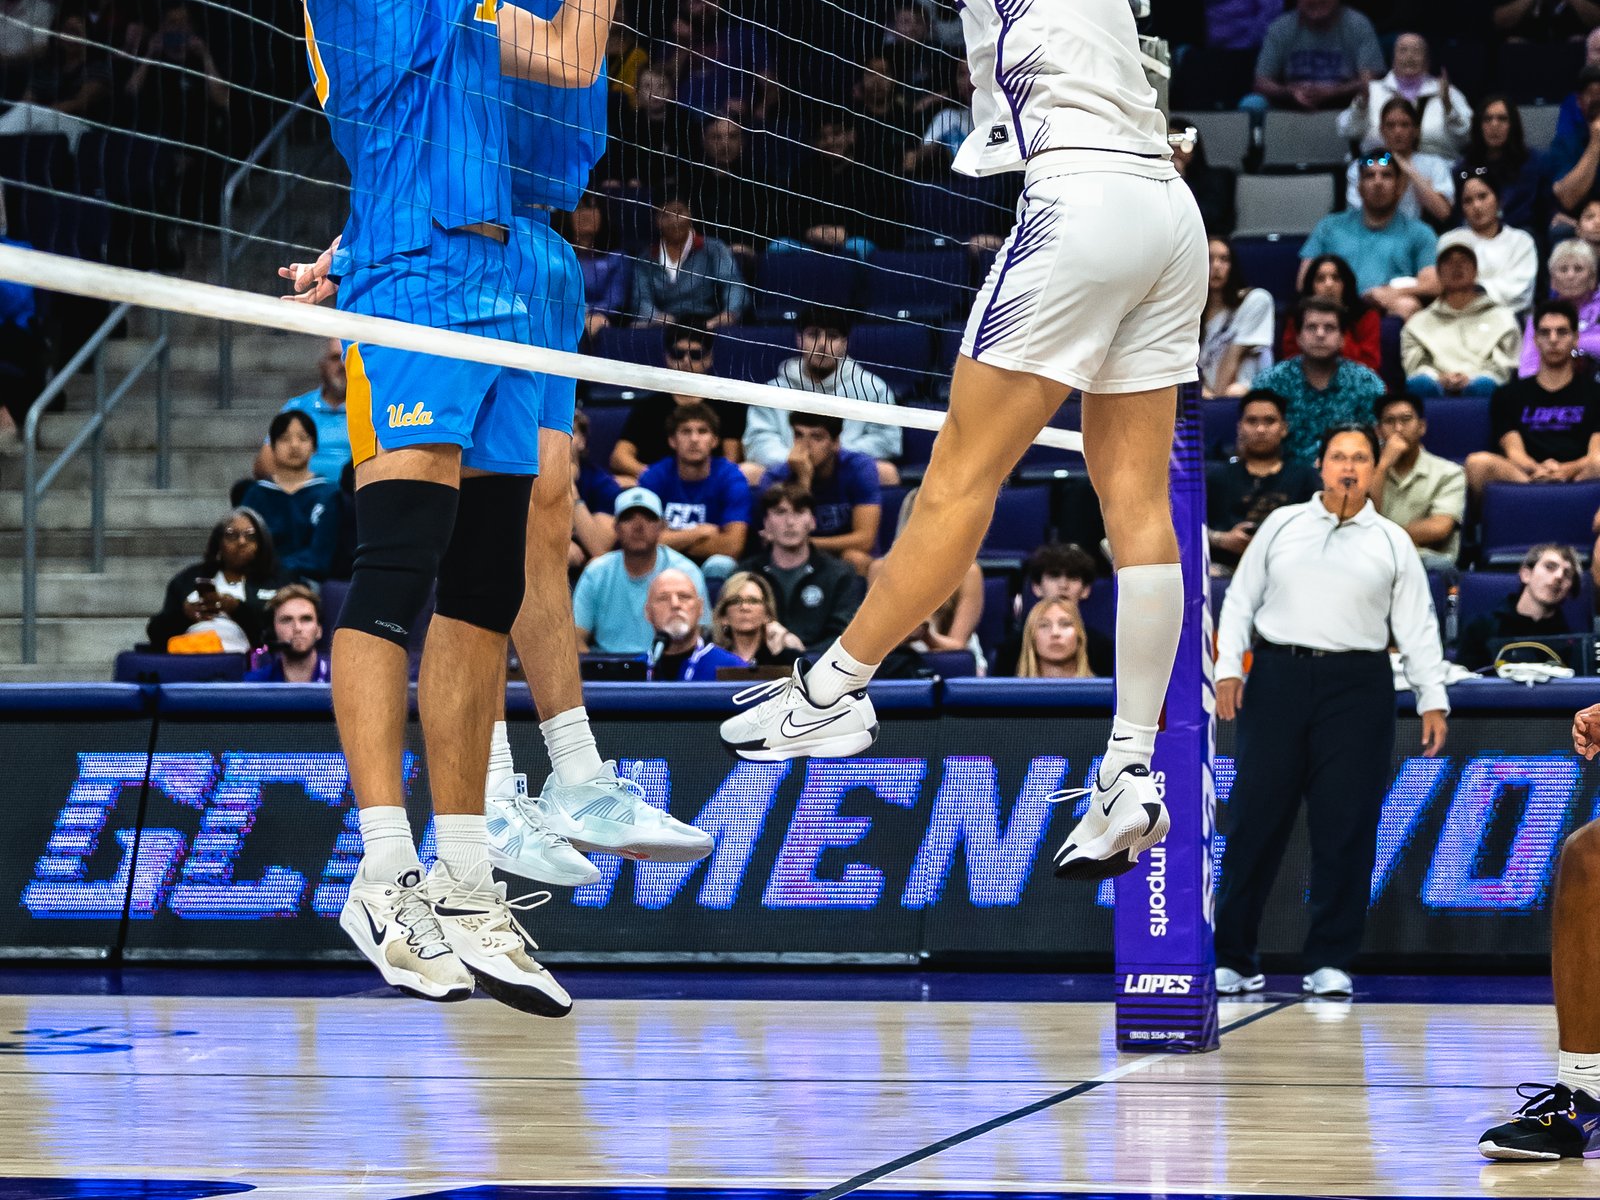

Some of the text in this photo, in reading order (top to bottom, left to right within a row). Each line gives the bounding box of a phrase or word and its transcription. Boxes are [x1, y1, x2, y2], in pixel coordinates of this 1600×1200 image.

[993, 131, 1005, 140] XL
[386, 401, 434, 429] Ucla
[1146, 846, 1170, 938] imports
[1124, 974, 1193, 994] LOPES
